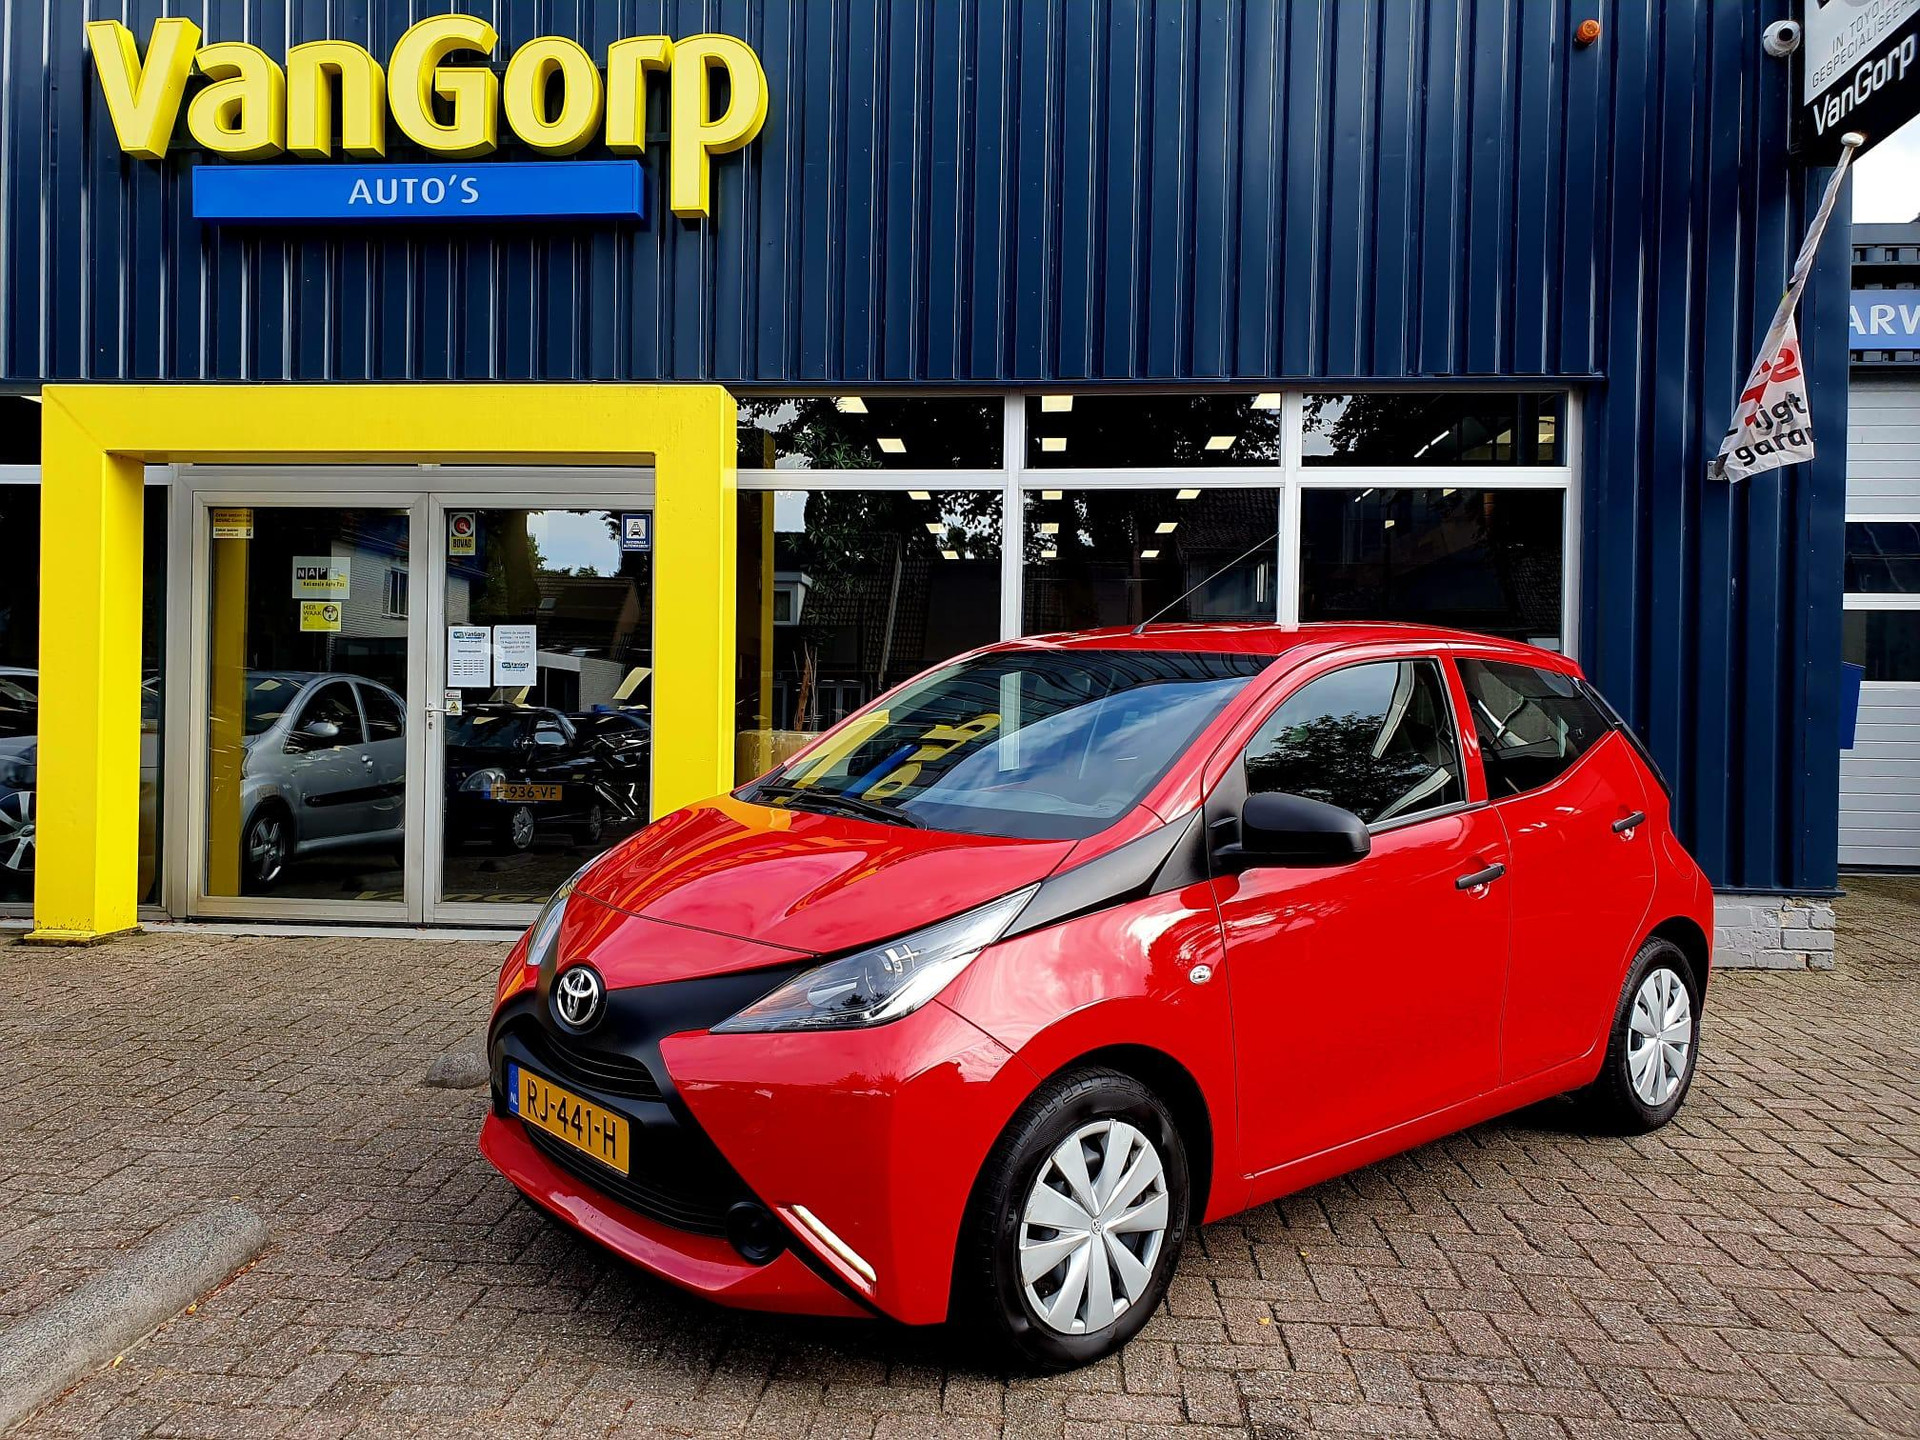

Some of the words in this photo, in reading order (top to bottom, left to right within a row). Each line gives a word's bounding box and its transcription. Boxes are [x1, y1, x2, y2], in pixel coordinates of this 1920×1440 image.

[1832, 32, 1844, 54] IN
[1850, 0, 1887, 38] TOYOT
[1813, 33, 1917, 136] VanGorp
[87, 14, 769, 218] VanGorp
[348, 174, 479, 205] AUTO'S
[297, 567, 328, 580] NAP
[509, 1091, 519, 1105] NL
[526, 1077, 617, 1160] RJ-441-H
